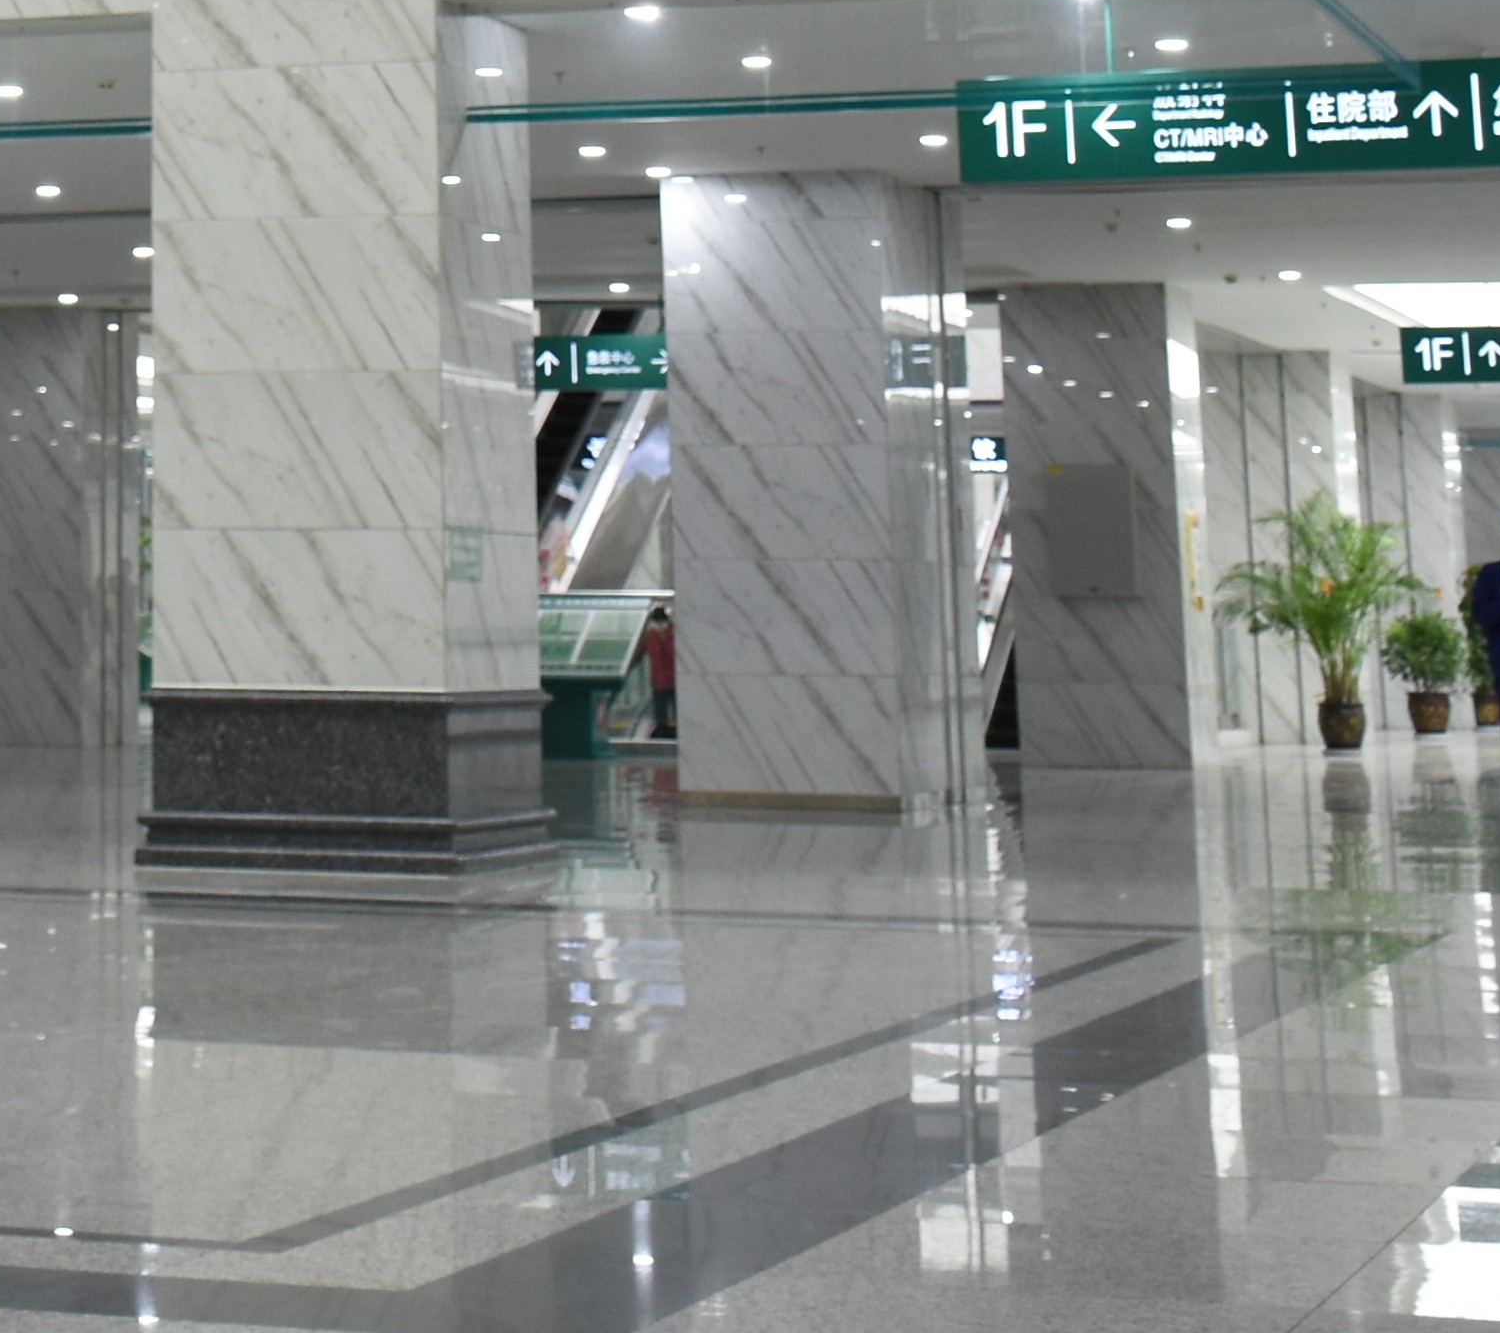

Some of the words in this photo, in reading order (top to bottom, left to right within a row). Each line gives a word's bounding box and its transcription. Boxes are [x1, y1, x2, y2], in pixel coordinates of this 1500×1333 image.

[1306, 89, 1398, 124] 住院部
[982, 100, 1047, 158] 1F
[1153, 121, 1269, 149] CT/MRI中心
[1415, 336, 1454, 371] 1F
